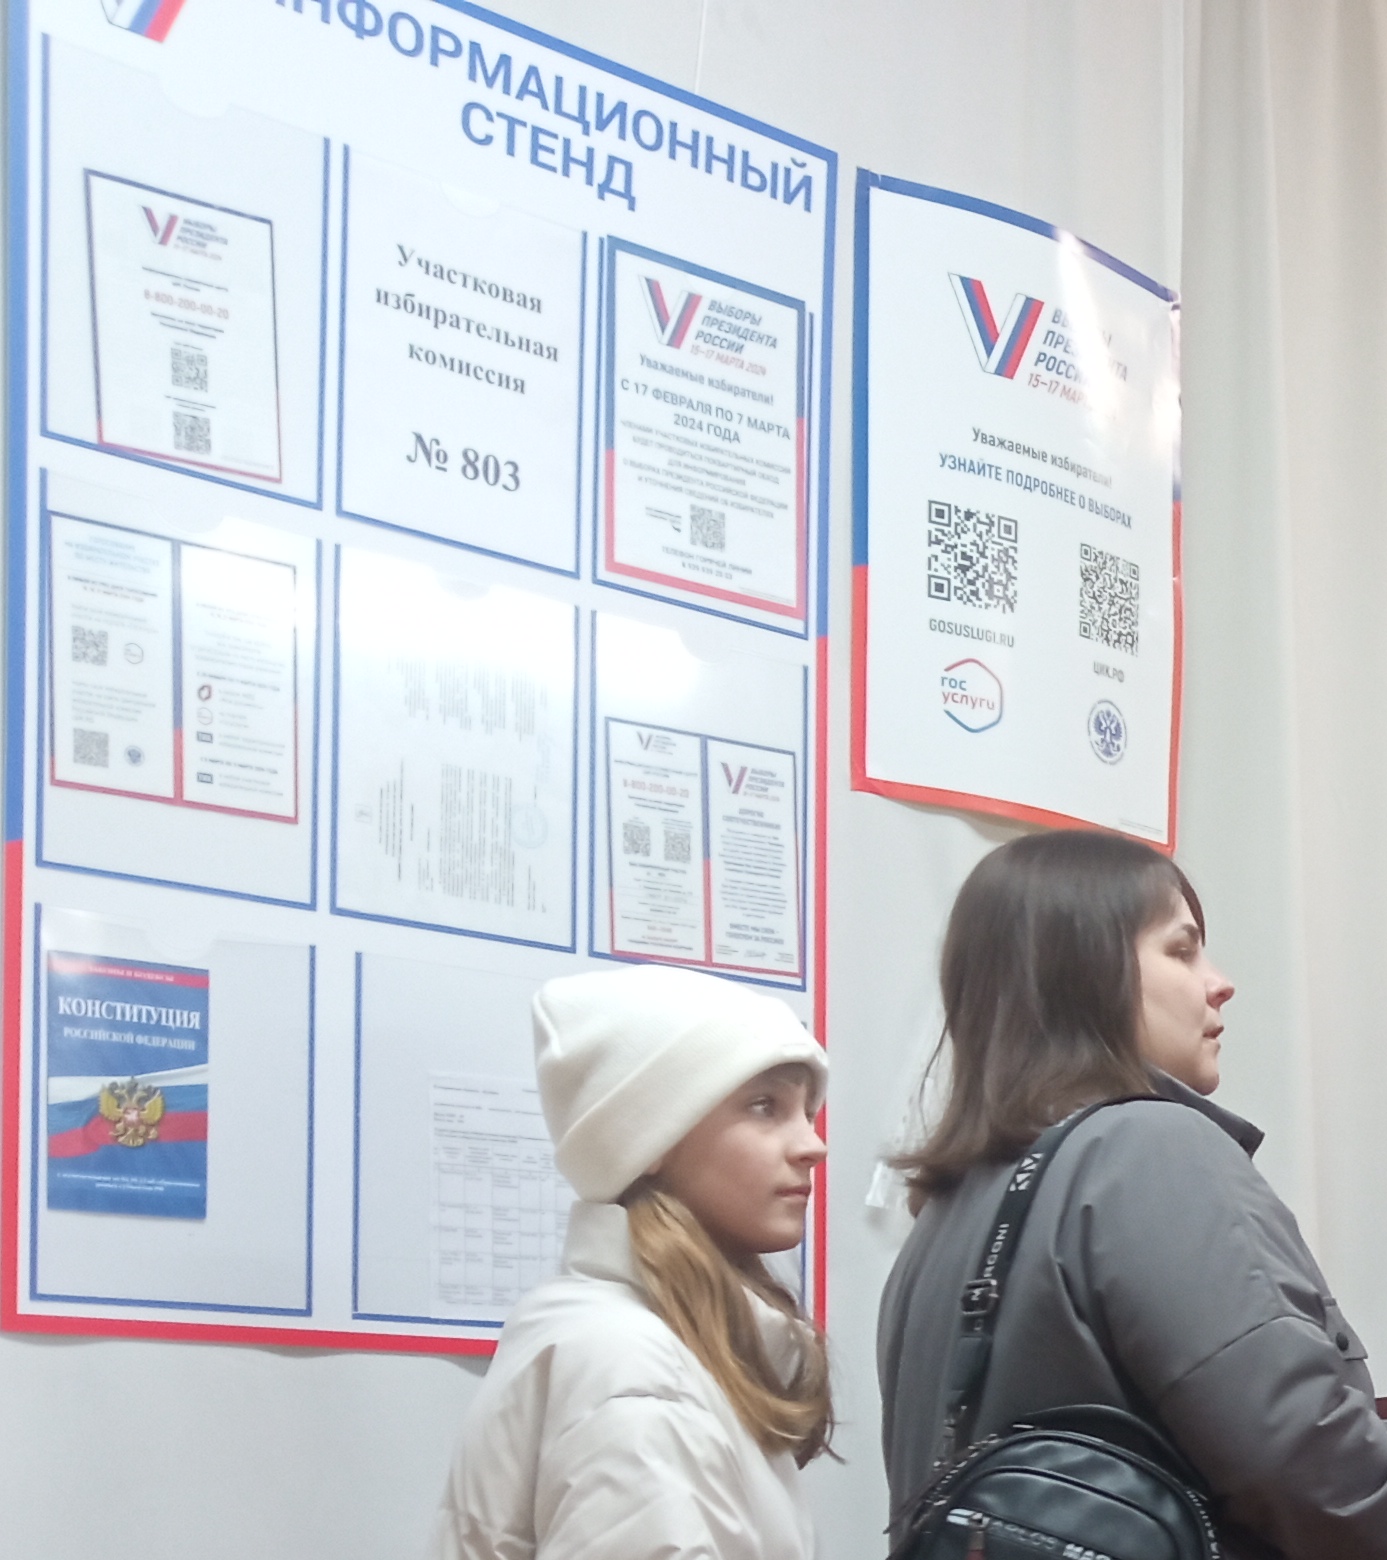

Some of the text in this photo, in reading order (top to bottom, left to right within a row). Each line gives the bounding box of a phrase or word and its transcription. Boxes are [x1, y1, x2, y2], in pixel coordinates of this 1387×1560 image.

[275, 0, 814, 213] ФОРМАЦИОННЫЙ
[460, 101, 637, 212] СТЕНД
[396, 243, 543, 314] Участковая
[375, 287, 559, 362] избирательная
[701, 316, 778, 350] ПРЕЗИДЕНТА
[707, 299, 763, 327] ВЫБОРЫ
[695, 330, 745, 355] РОССИИ
[408, 343, 526, 395] комиссия
[639, 353, 774, 406] Уважаемые избиратели!
[1034, 352, 1089, 387] РОССИ
[621, 378, 791, 440] С 17 ФЕВРАЛЯ ПО 7 МАРТА
[673, 413, 741, 444] 2024 ГОДА
[406, 431, 521, 492] № 803
[972, 427, 1113, 490] Уважаемые избиратели!
[938, 452, 1133, 530] УЗНАЙТЕ ПОДРОБНЕЕ О ВЫБОРАХ
[929, 617, 1015, 648] GOSUSLUGI.RU
[940, 675, 967, 692] гос
[1093, 660, 1126, 684] ЦИК.РФ
[58, 995, 201, 1031] КОНСТИТУЦИЯ
[63, 1026, 196, 1051] РОССИЙСКОЙ ФЕДЕРАЦИИ
[970, 1223, 1010, 1301] MRCONI
